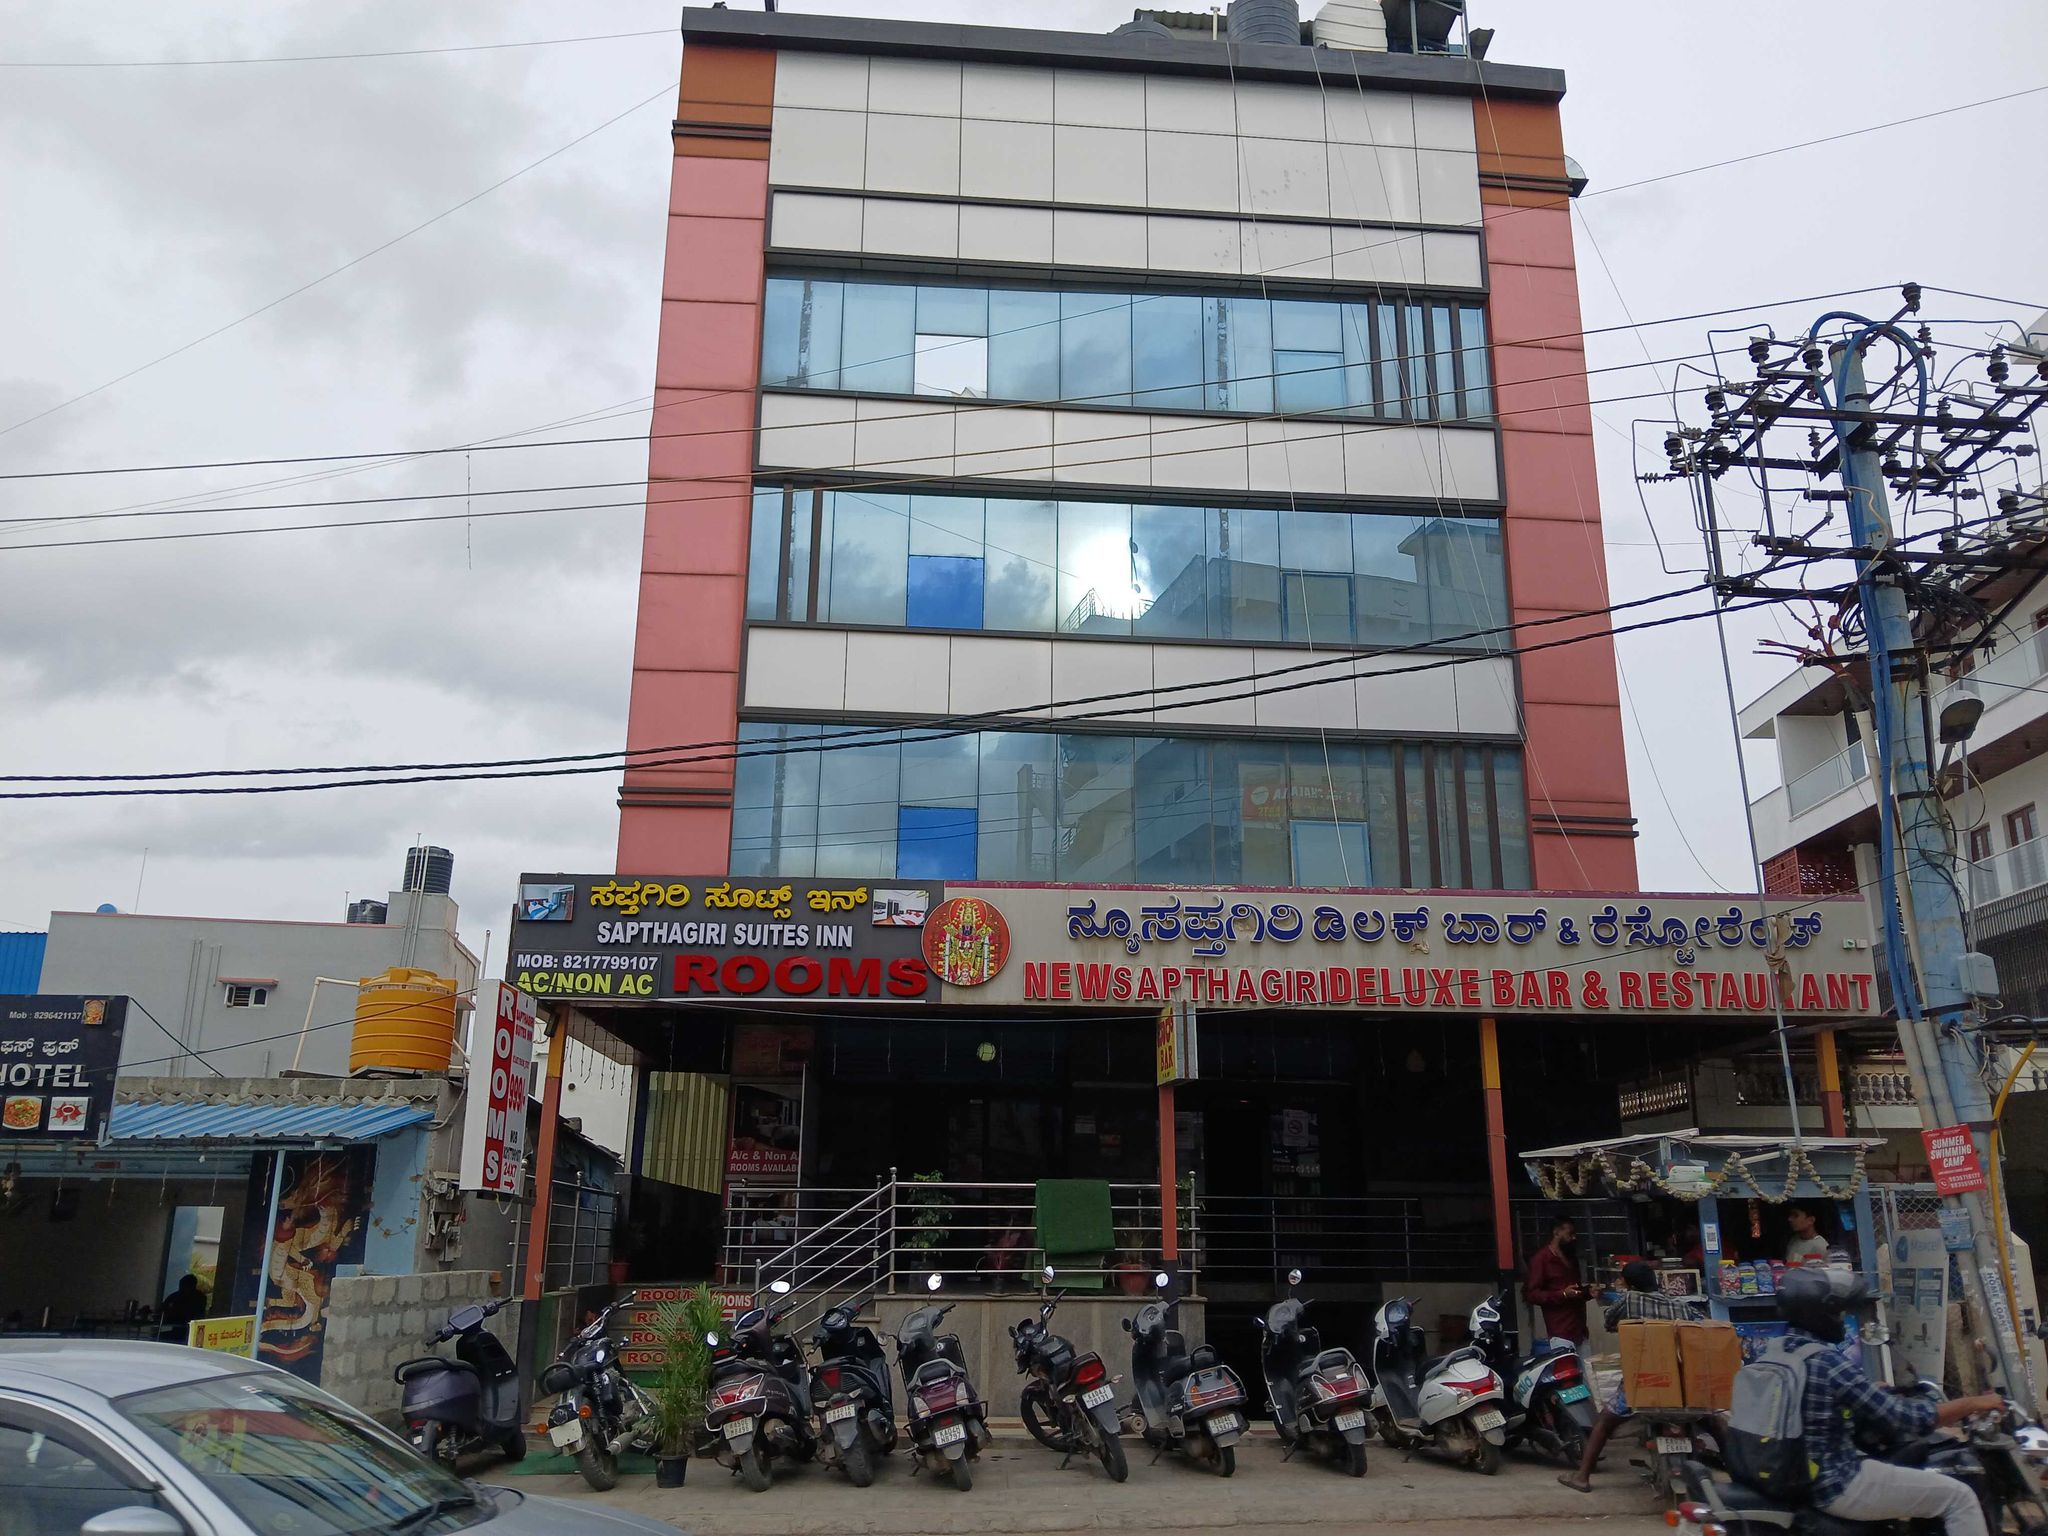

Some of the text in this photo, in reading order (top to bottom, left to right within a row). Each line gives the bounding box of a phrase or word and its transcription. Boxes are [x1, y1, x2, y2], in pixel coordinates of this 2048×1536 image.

[590, 880, 868, 919] ಸಪ್ತಗಿರಿ ಸೂಟ್ಸ್ ಇನ್
[597, 920, 853, 948] SAPTHAGIRI SUITES INN
[1442, 906, 1548, 945] ಬಾರ್
[1557, 917, 1581, 946] &
[517, 954, 658, 971] MOB: 8217799107
[517, 971, 654, 995] AC/NON AC
[672, 953, 929, 998] ROOMS
[1490, 969, 1572, 1009] BAR
[1581, 970, 1610, 1008] &
[1160, 1046, 1173, 1071] BAR
[485, 987, 515, 1182] ROOMS
[1930, 1144, 1972, 1160] SWIMMING
[1932, 1135, 1965, 1149] SUMMER
[730, 1163, 760, 1172] ROOMS
[752, 1151, 761, 1160] &
[765, 1151, 786, 1160] Non
[1943, 1156, 1965, 1168] CAMP
